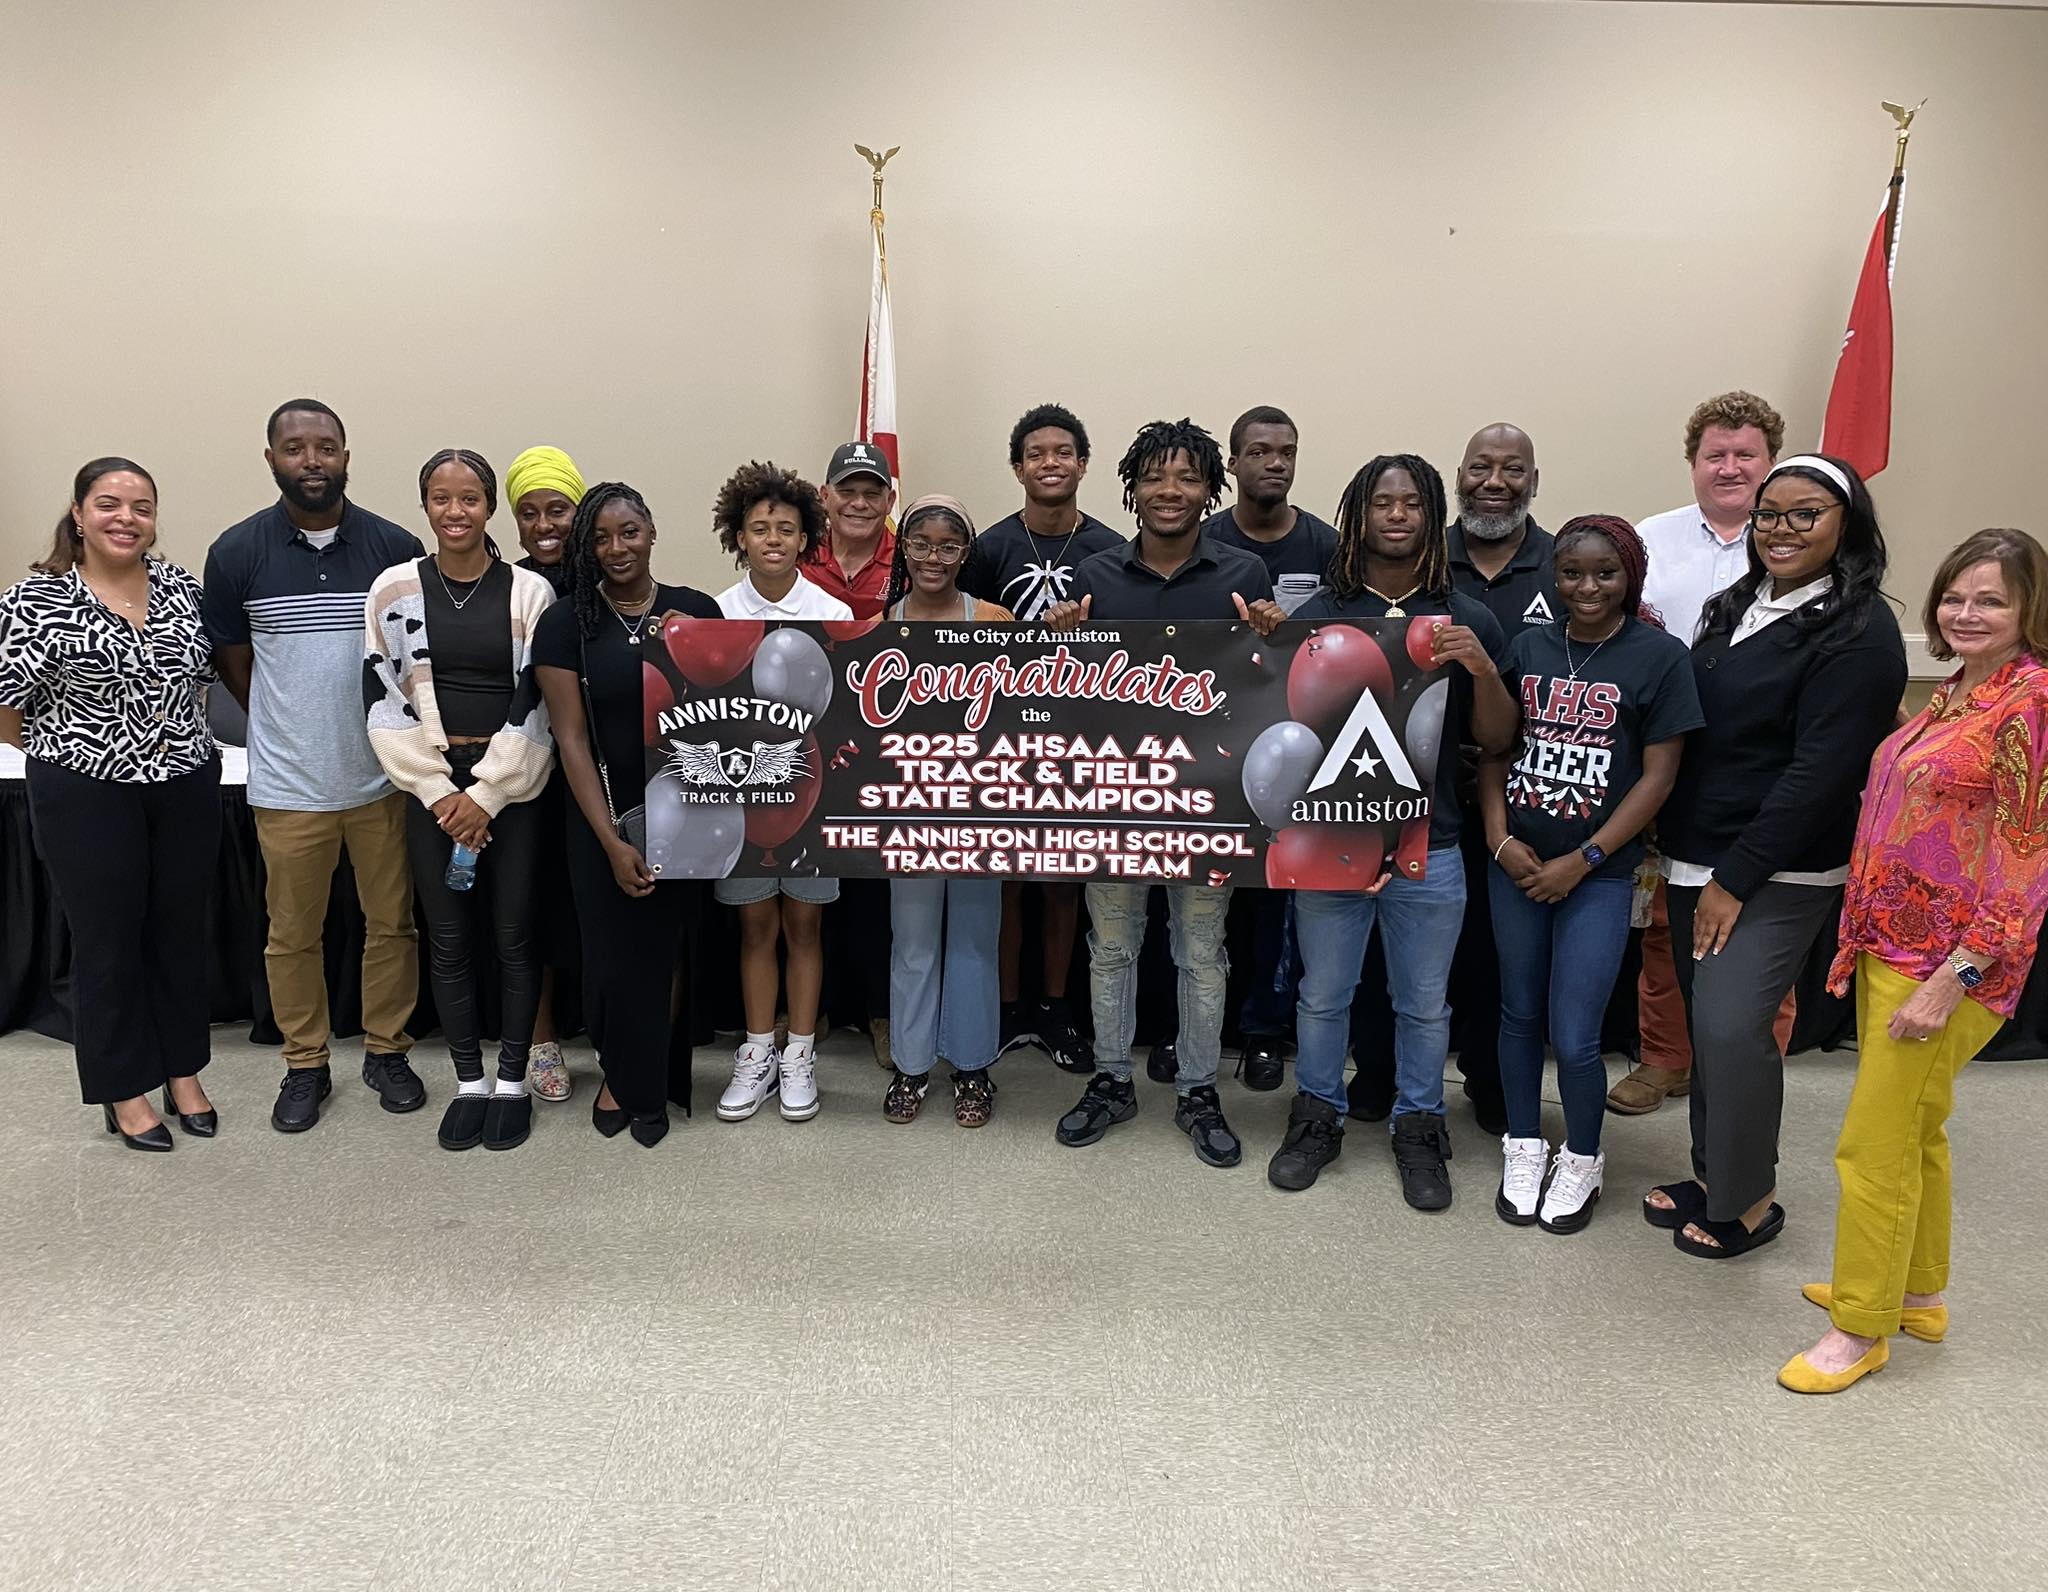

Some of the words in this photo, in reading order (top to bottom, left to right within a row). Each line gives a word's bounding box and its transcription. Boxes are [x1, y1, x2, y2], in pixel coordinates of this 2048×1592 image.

[935, 629, 970, 643] The
[973, 628, 1012, 646] City
[1014, 629, 1036, 643] of
[1037, 628, 1121, 643] Anniston
[846, 645, 1227, 731] Congratulates
[1521, 674, 1621, 729] AHS
[657, 696, 814, 736] ANNISTON
[1020, 708, 1051, 722] the
[1523, 714, 1616, 747] niston
[879, 734, 979, 758] 2025
[988, 734, 1122, 759] AHSAA
[1136, 735, 1196, 761] 4A
[896, 760, 1028, 784] TRACK
[1035, 761, 1062, 785] &
[1072, 761, 1177, 786] FIELD
[680, 791, 730, 804] TRACK
[735, 792, 746, 804] &
[751, 791, 796, 804] FIELD
[858, 784, 971, 809] STATE
[979, 785, 1216, 814] CHAMPIONS
[1291, 793, 1430, 824] anniston
[822, 826, 879, 849] THE
[885, 826, 1037, 851] ANNISTON
[1044, 828, 1116, 852] HIGH
[1124, 831, 1254, 857] SCHOOL
[882, 849, 982, 873] TRACK
[989, 851, 1011, 874] &
[1018, 851, 1098, 875] FIELD
[1104, 853, 1191, 878] TEAM
